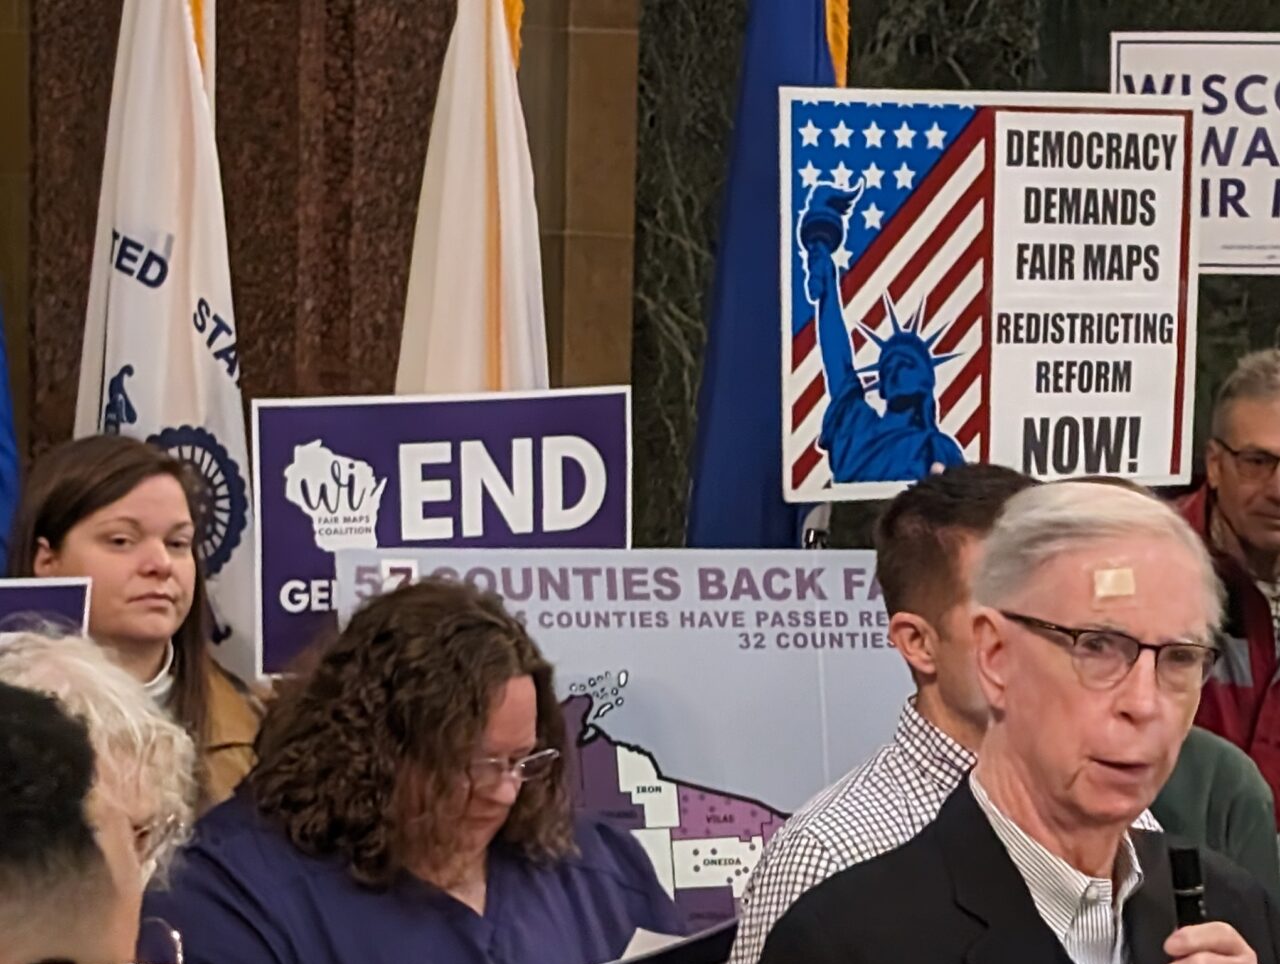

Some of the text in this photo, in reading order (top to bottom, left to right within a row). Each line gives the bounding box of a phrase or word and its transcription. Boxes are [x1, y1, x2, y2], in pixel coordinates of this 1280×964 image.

[1006, 129, 1177, 171] DEMOCRACY
[1024, 186, 1156, 226] DEMANDS
[1016, 243, 1160, 281] FAIR MAPS
[996, 312, 1174, 344] REDISTRICTING
[1036, 360, 1132, 393] REFORM
[1022, 416, 1142, 475] NOW!
[399, 435, 607, 541] END
[698, 567, 826, 601] BACK
[538, 611, 669, 629] COUNTIES
[680, 611, 745, 628] HAVE
[756, 610, 849, 628] PASSED
[738, 632, 766, 649] 32
